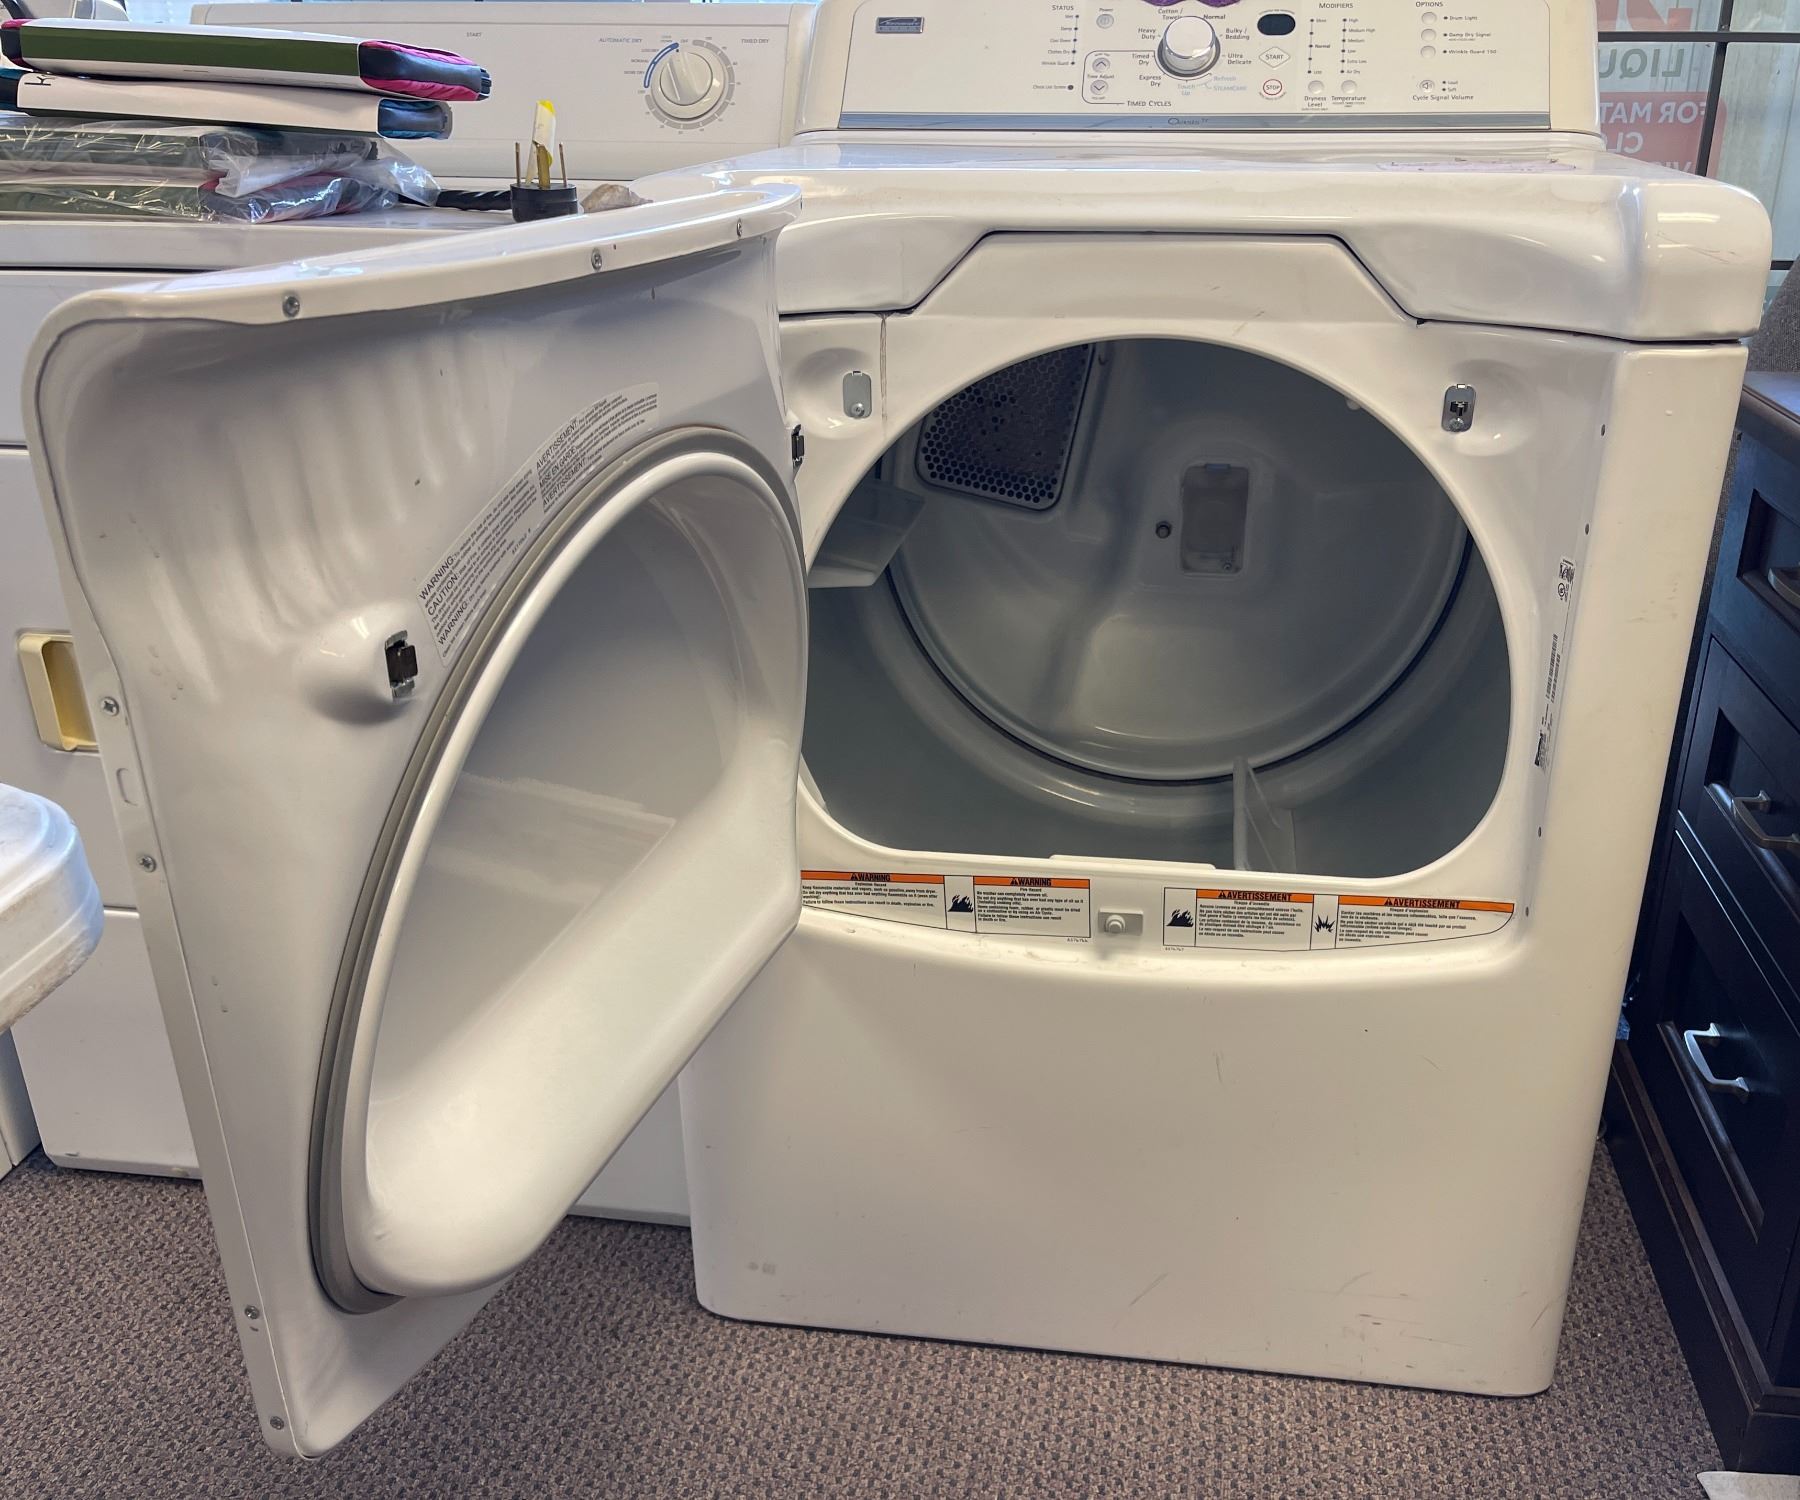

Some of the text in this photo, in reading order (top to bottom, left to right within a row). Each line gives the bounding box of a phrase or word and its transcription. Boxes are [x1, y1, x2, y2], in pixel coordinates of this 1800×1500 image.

[859, 873, 890, 881] WARNING
[1018, 878, 1051, 887] WARNING
[1227, 891, 1292, 902] AVERTISSEMENT
[1393, 898, 1461, 909] AVERTISSEMENT
